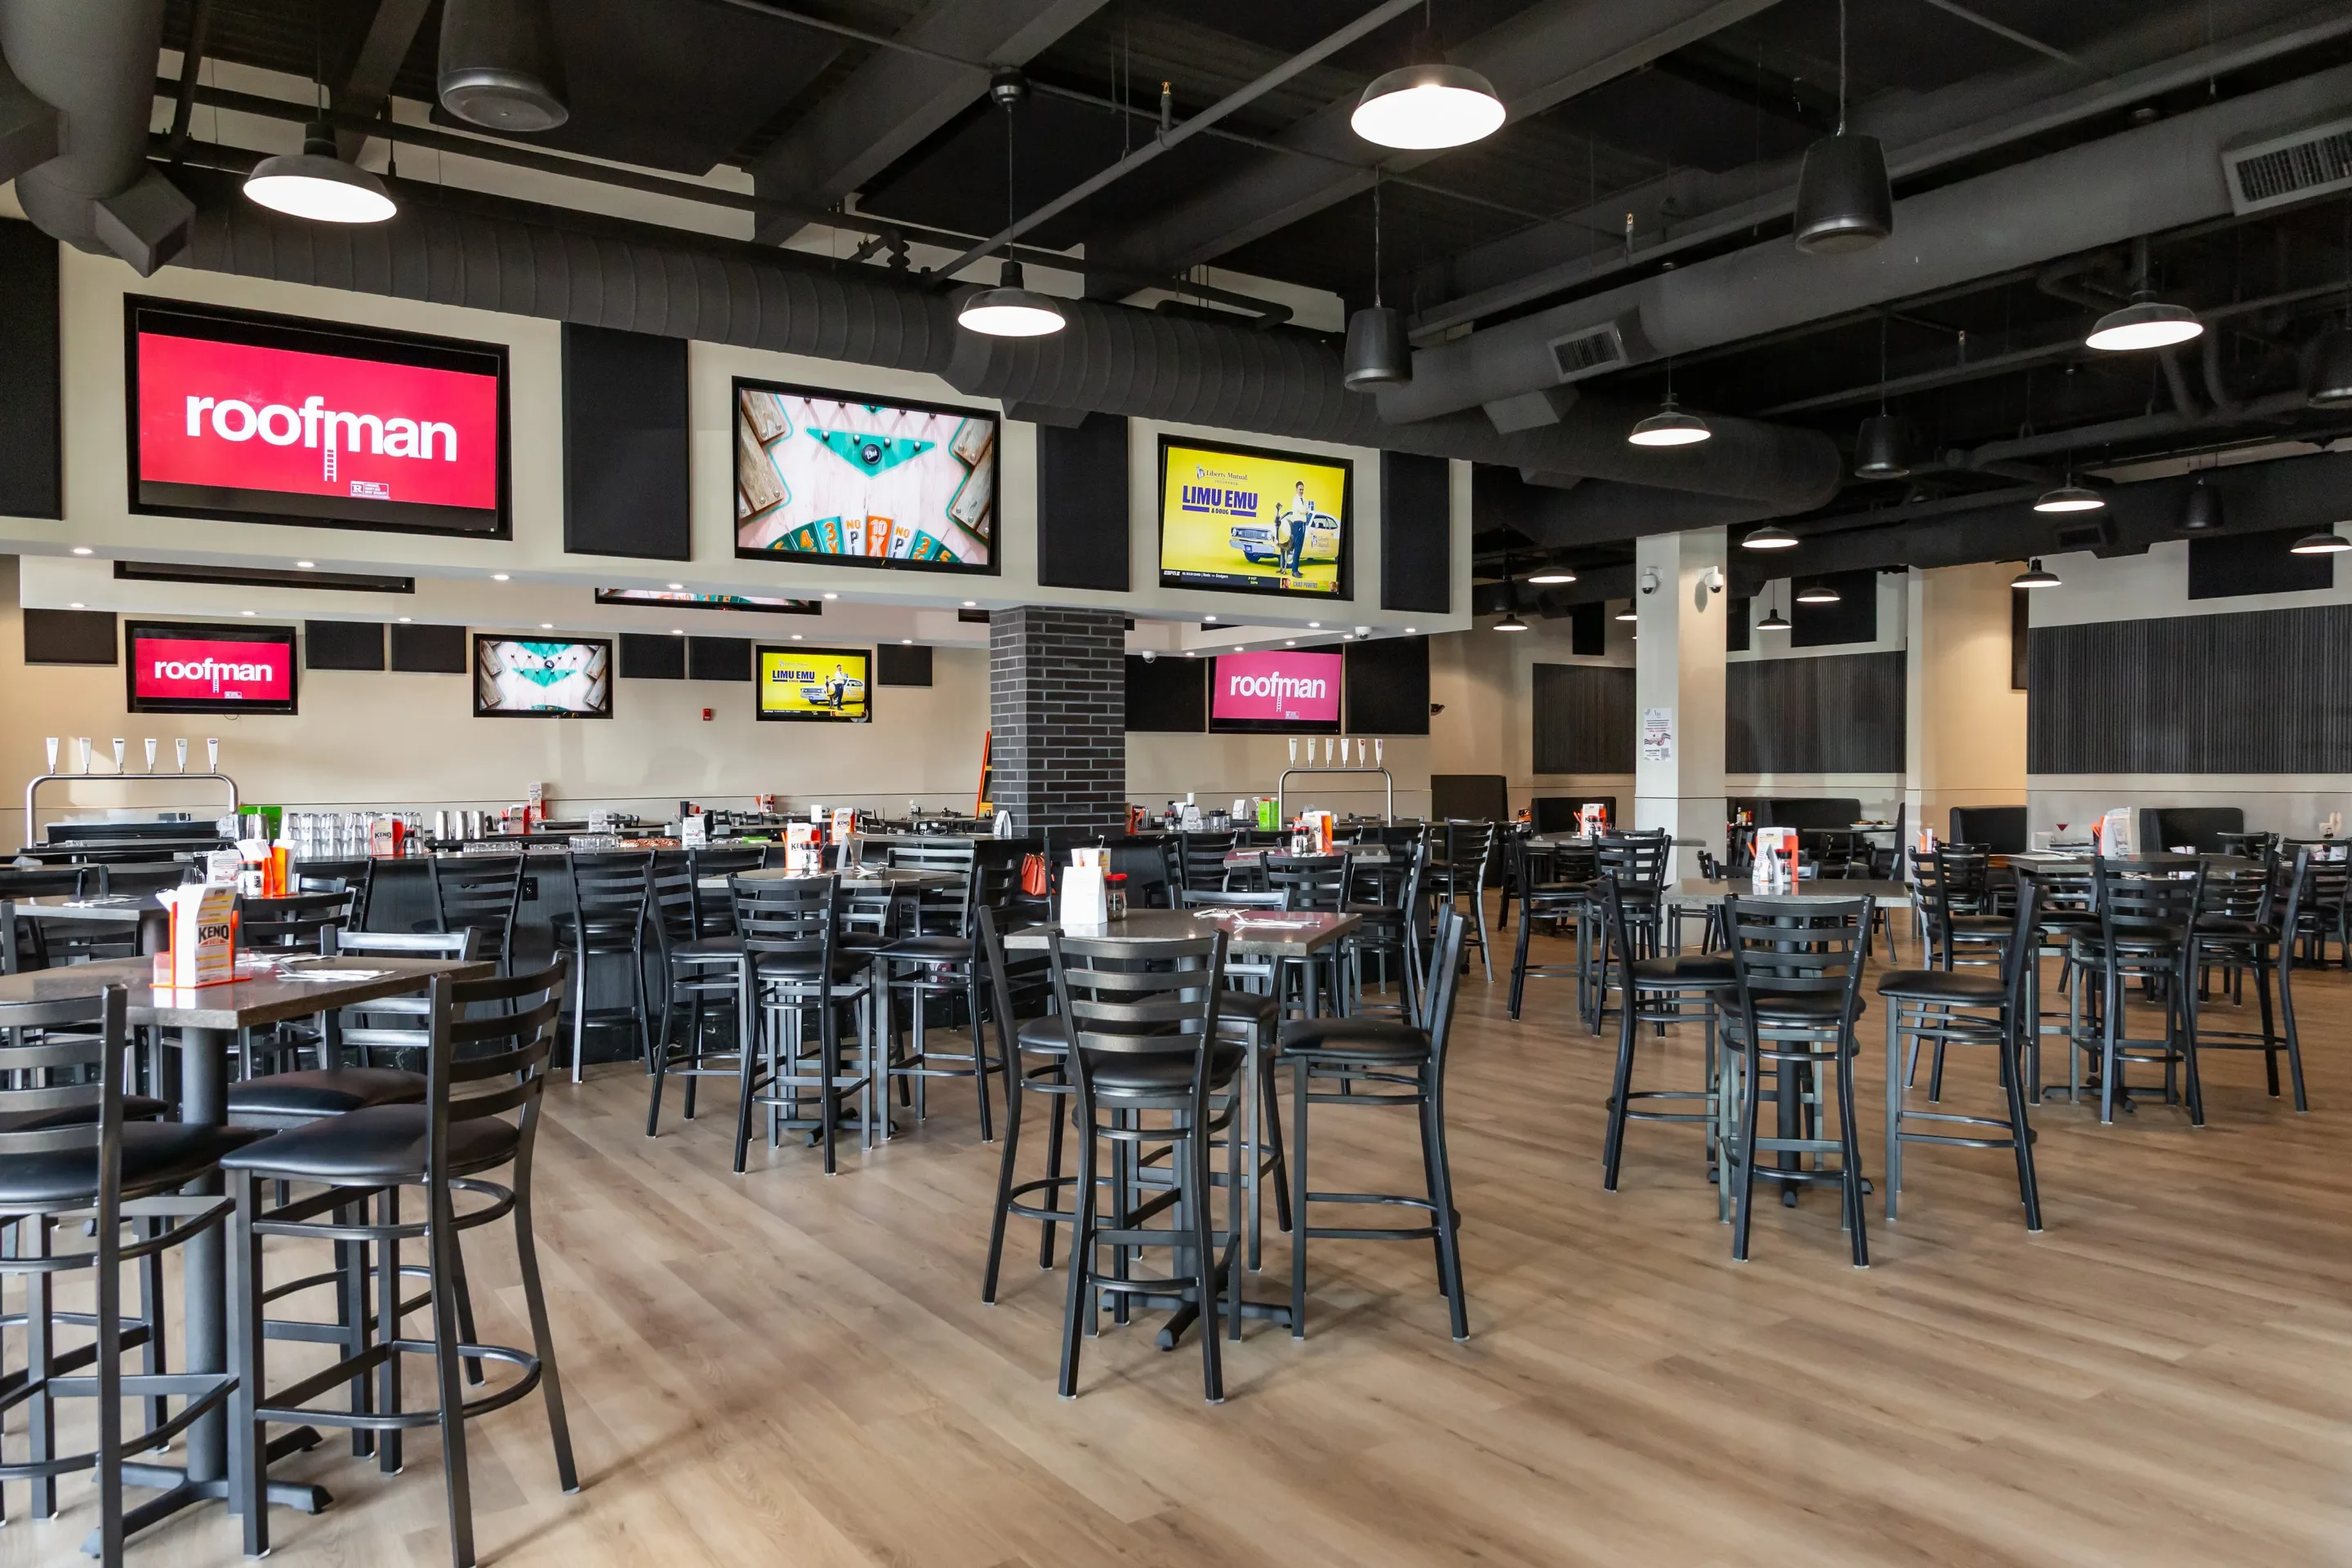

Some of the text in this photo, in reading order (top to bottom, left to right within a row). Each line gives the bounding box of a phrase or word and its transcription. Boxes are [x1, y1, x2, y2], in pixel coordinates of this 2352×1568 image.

[186, 396, 457, 482] roofman
[1206, 470, 1248, 480] Liberty Mutual
[352, 484, 363, 493] R
[1182, 485, 1258, 510] LIMU EMU
[824, 522, 837, 541] 3
[845, 519, 862, 529] NO
[870, 519, 888, 536] 10
[895, 526, 911, 538] NO
[800, 529, 813, 548] 4
[916, 537, 931, 555] 3
[154, 657, 272, 693] roofman
[773, 670, 814, 679] LIMU EMU
[1231, 671, 1325, 712] roofman
[198, 924, 229, 943] KENO
